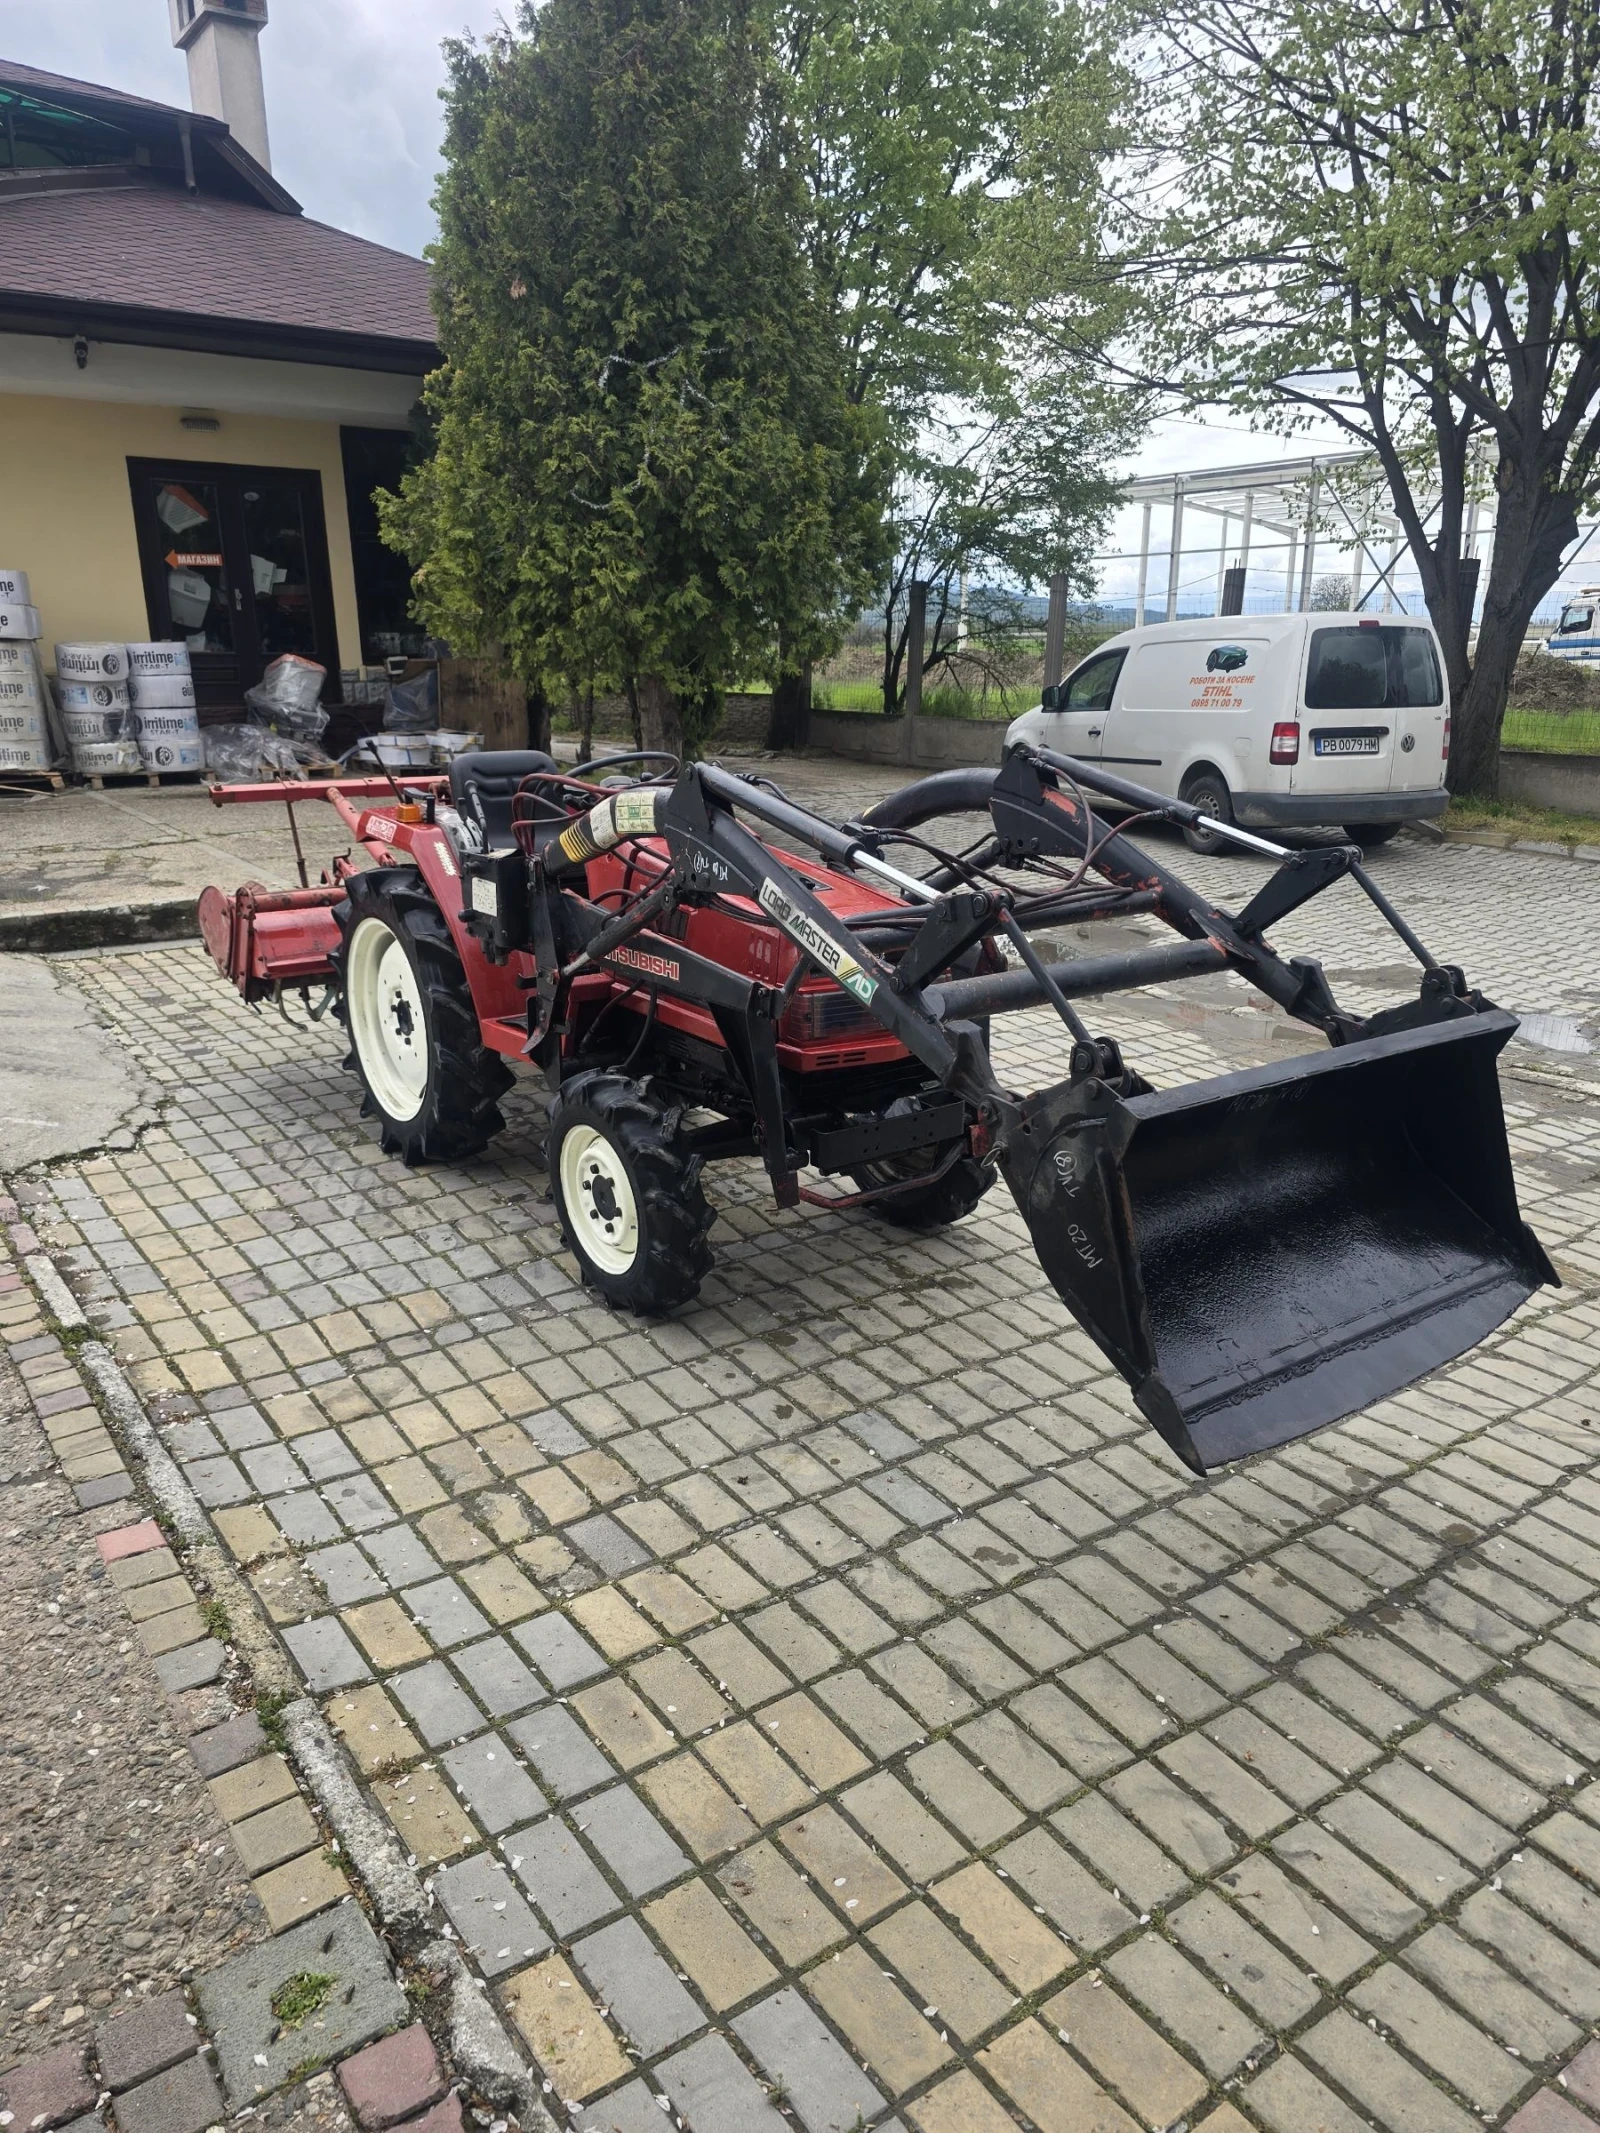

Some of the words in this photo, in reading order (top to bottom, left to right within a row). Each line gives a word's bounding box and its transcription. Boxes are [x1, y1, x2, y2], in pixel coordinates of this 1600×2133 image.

[177, 555, 220, 565] МАГАЗИН
[133, 651, 174, 664] irritime
[61, 658, 100, 674] irritime
[1190, 677, 1216, 685] РОБОТИ
[1226, 675, 1255, 684] КОСЕНЕ
[1202, 686, 1232, 697] STIHL
[1191, 699, 1209, 707] 0895
[1210, 699, 1219, 707] 71
[1232, 698, 1242, 707] 79
[144, 717, 184, 729] irritime
[1323, 740, 1337, 752] PB
[1339, 739, 1363, 751] 0079
[1364, 739, 1377, 750] HM
[762, 884, 791, 921] LOAD
[789, 915, 841, 970] MASTER
[604, 948, 680, 981] TSUBISHI
